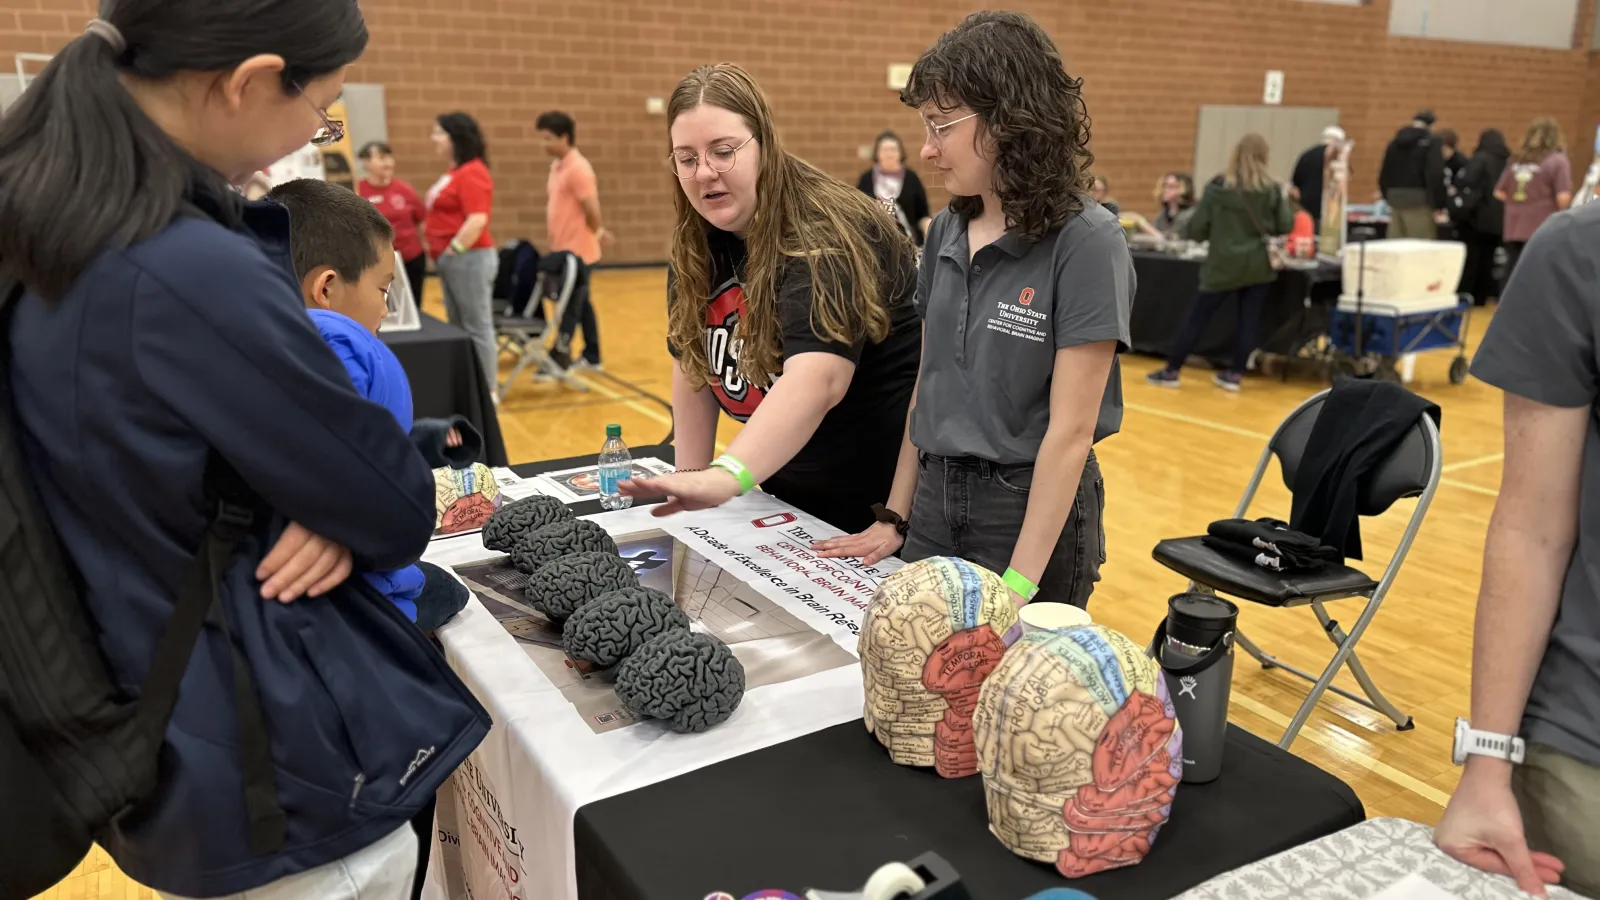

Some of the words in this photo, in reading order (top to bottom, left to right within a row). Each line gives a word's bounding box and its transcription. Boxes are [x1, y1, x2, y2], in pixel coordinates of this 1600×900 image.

[997, 302, 1009, 310] THE
[1010, 304, 1026, 315] OHIO
[1026, 309, 1047, 320] STATE
[999, 310, 1039, 326] UNIVERSITY
[987, 324, 1011, 335] BEHAVIORAL
[1011, 330, 1025, 338] BRAIN
[1025, 334, 1045, 343] IMAGING
[988, 318, 1003, 327] CENTER
[1002, 321, 1012, 329] FOR
[1012, 324, 1036, 335] COGNITIVE
[776, 541, 814, 560] CENTER
[810, 559, 834, 572] FOR
[693, 529, 728, 550] Decade
[783, 586, 800, 594] in
[795, 593, 830, 613] Brain
[940, 565, 955, 590] CORTEX
[812, 577, 849, 597] BRAIN
[875, 579, 919, 620] FRONTAL
[896, 587, 921, 606] LOBE
[950, 593, 961, 623] MOTOR
[968, 587, 978, 620] SENSORY
[942, 650, 988, 677] TEMPORAL
[968, 659, 989, 669] LOBE
[1031, 680, 1054, 713] LOBE
[1086, 674, 1111, 705] MOTOR
[1010, 671, 1042, 736] FRONTAL
